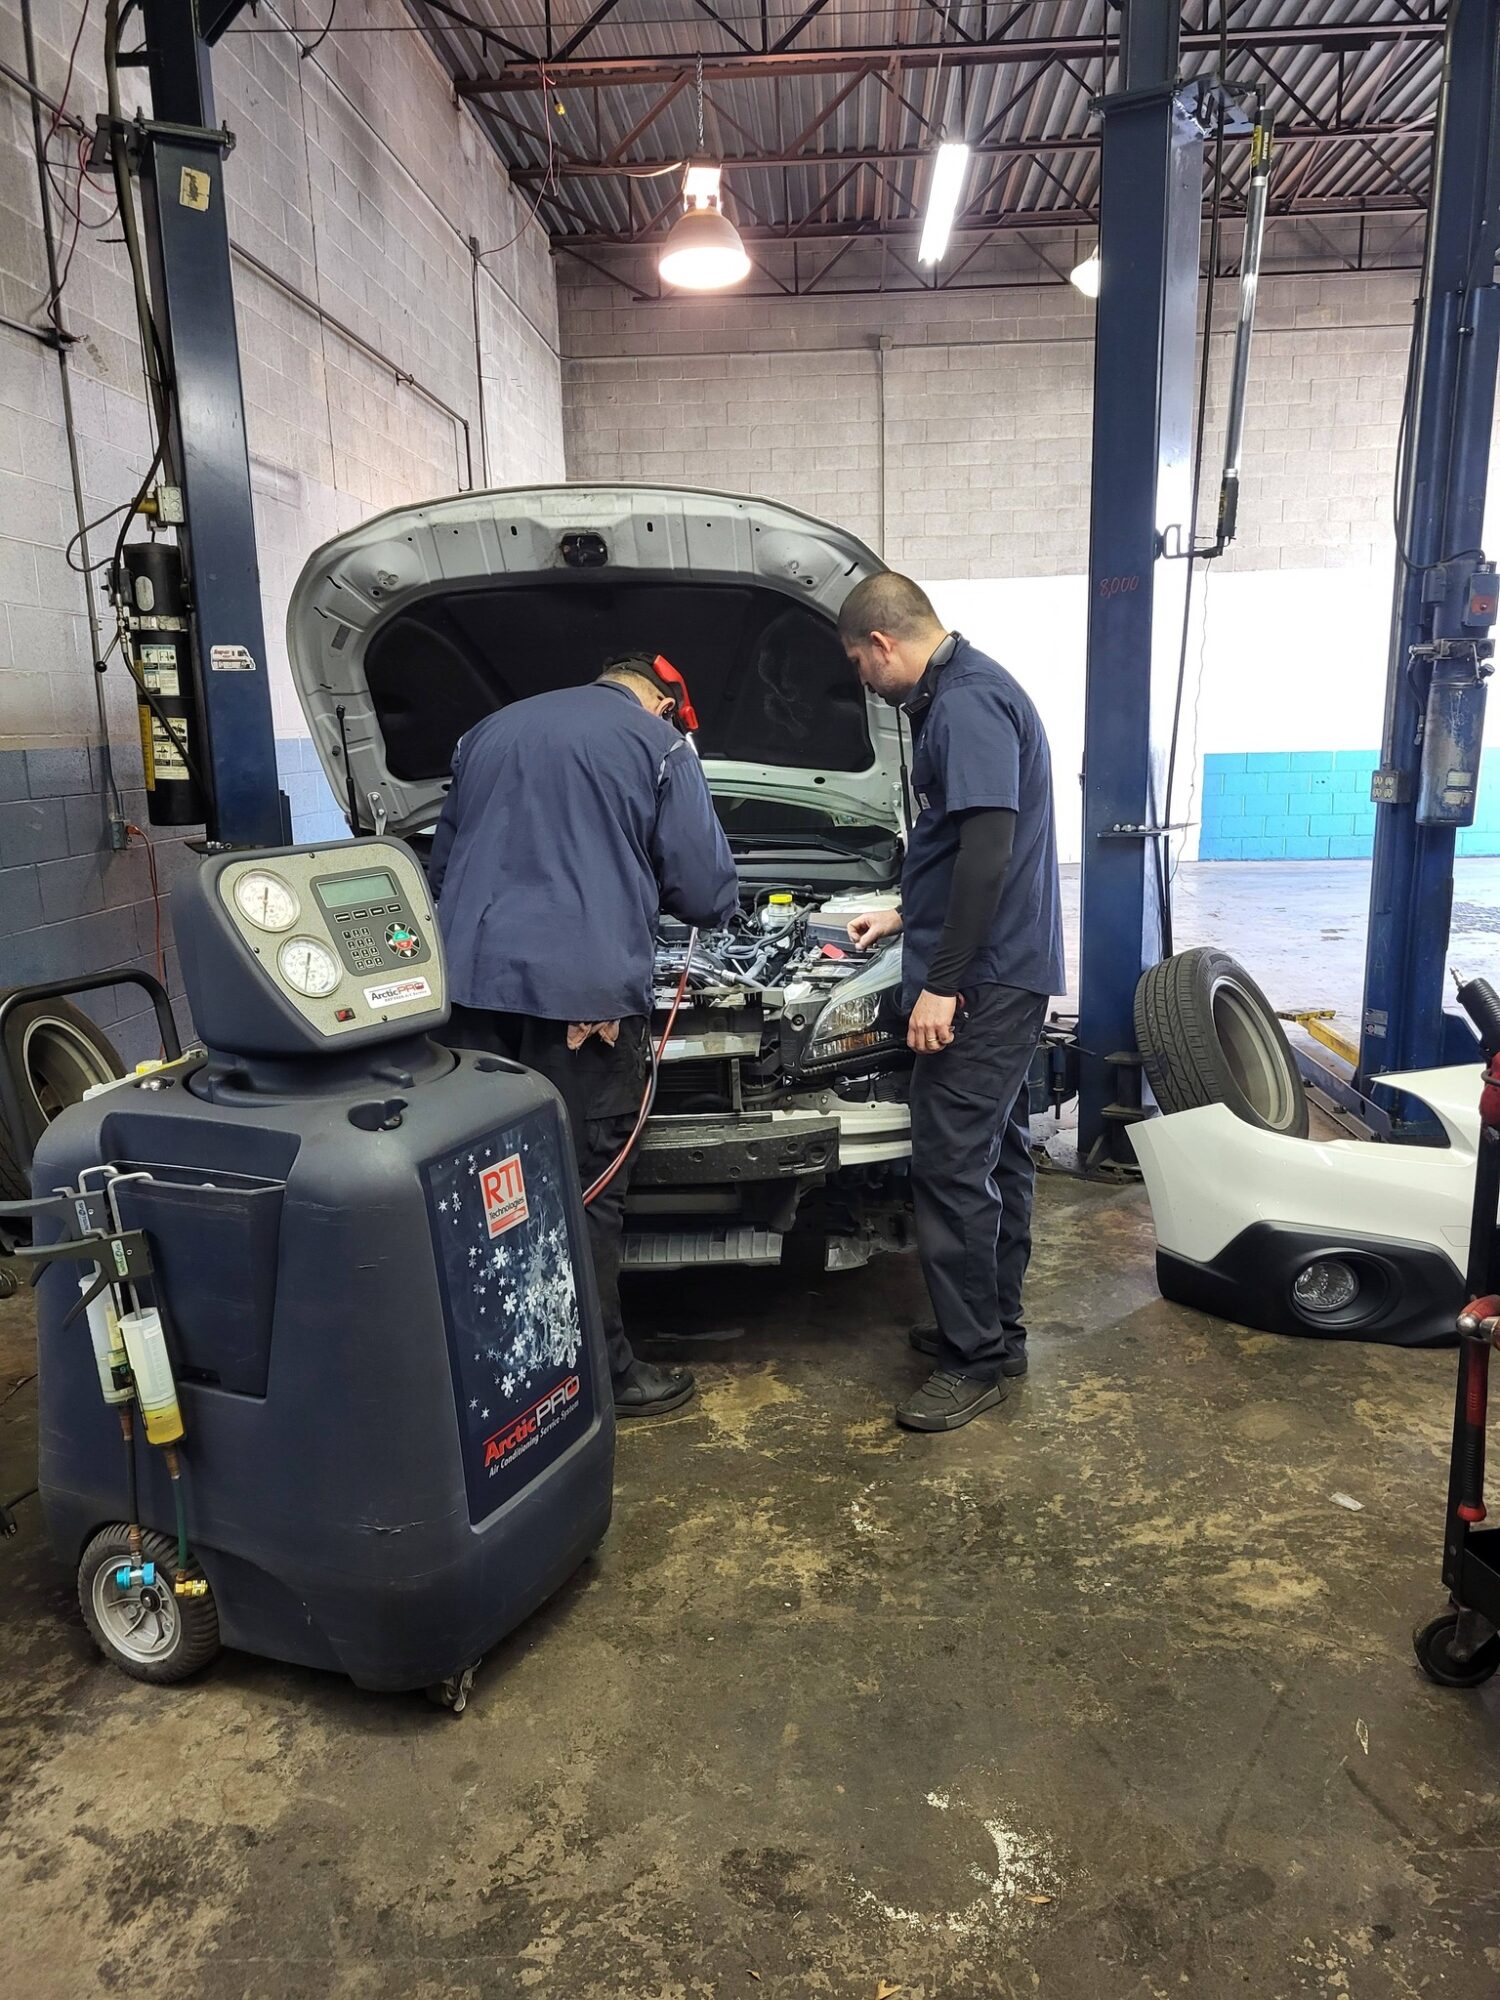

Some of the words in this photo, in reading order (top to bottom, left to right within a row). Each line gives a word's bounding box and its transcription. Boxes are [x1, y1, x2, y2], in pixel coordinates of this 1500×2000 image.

[371, 982, 424, 1000] ArcticPRO
[483, 1160, 523, 1209] RTI
[489, 1196, 525, 1220] Technologies
[484, 1375, 579, 1467] ArcticPRO
[489, 1464, 500, 1479] Air
[501, 1434, 539, 1469] Conditioning
[540, 1416, 560, 1438] Service
[561, 1400, 579, 1421] System
